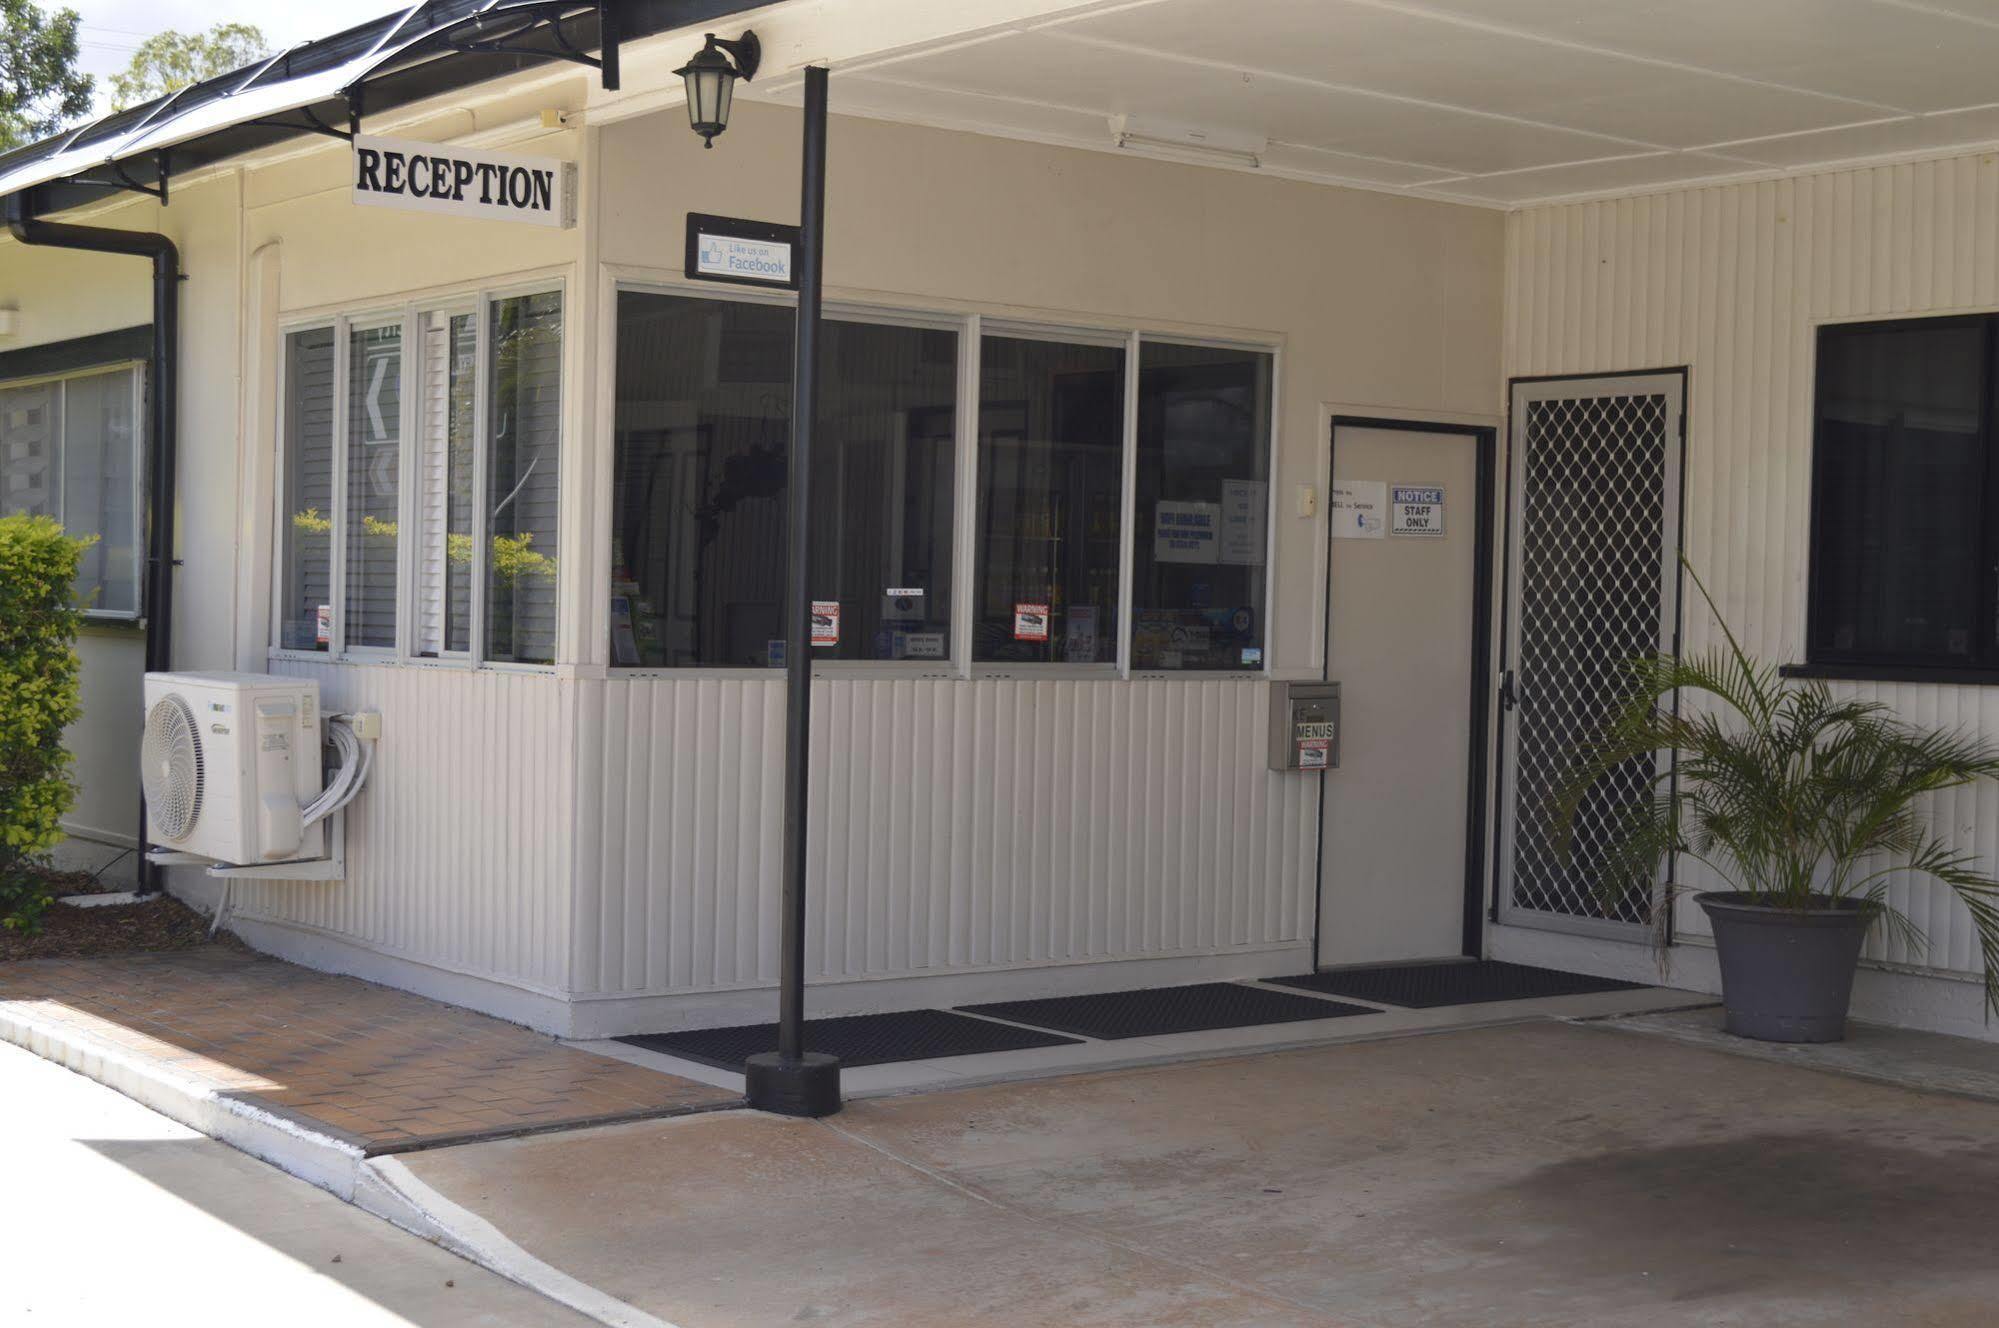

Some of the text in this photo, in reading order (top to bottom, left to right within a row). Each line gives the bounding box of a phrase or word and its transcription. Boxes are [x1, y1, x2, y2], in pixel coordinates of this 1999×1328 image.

[357, 148, 553, 211] RECEPTION
[729, 243, 769, 256] Like us on
[729, 255, 785, 273] Facebook
[1398, 490, 1438, 501] NOTICE
[1404, 505, 1431, 516] STAFF
[1406, 518, 1430, 528] ONLY
[811, 605, 839, 616] ARNING
[1016, 604, 1048, 615] WARNING
[1297, 724, 1333, 738] MENUS
